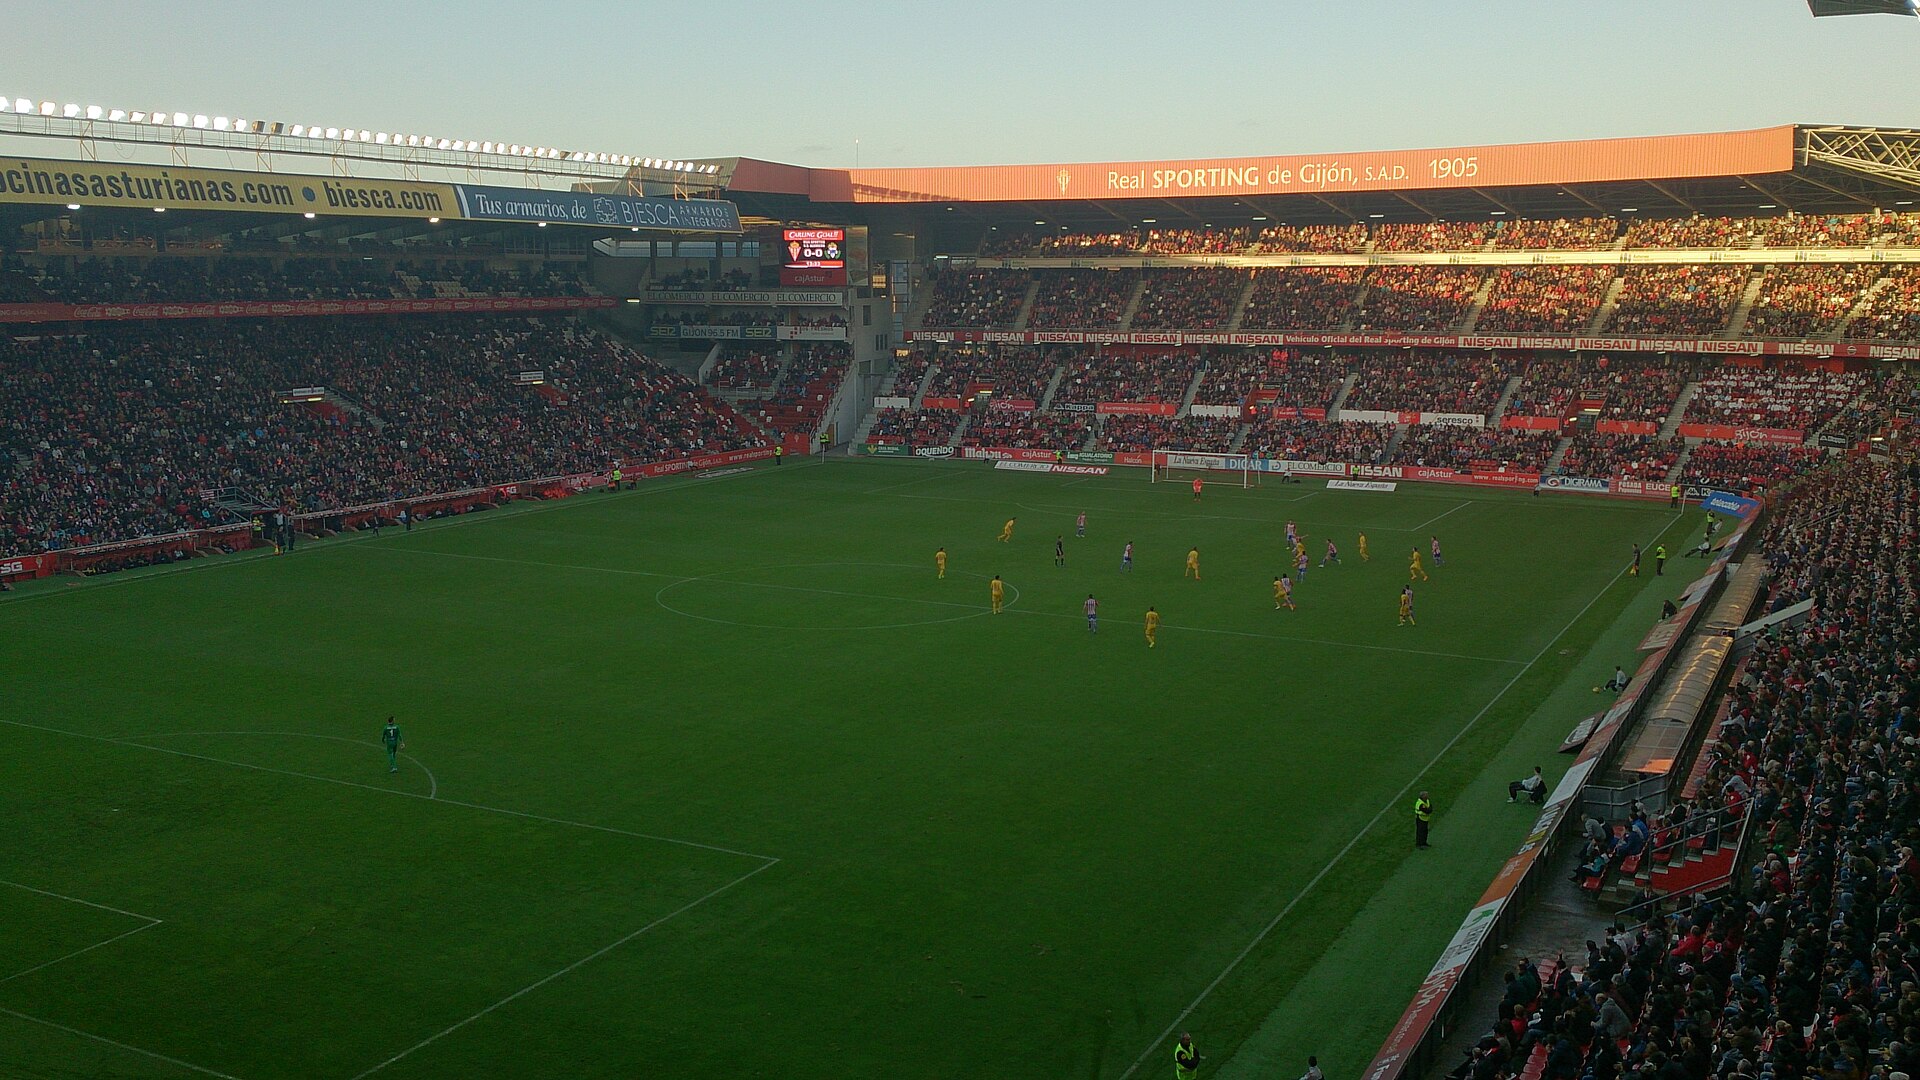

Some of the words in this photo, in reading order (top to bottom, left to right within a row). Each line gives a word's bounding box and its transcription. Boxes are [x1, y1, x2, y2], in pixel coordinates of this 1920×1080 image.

[1107, 170, 1146, 190] Real
[1151, 166, 1260, 189] SPORTING
[1267, 164, 1292, 185] de
[1299, 160, 1359, 189] Gijón,
[1364, 165, 1410, 181] S.A.D.
[1428, 156, 1479, 179] 1905
[323, 181, 443, 211] biesca.com
[475, 193, 502, 215] Tus
[505, 198, 570, 222] armarios,
[572, 203, 587, 220] de
[620, 200, 681, 226] BIESCA
[680, 204, 731, 219] ARMARIOS
[681, 216, 733, 229] INTEGRADOS
[803, 248, 823, 258] 0-0
[794, 274, 825, 283] cajAstur
[711, 293, 722, 301] EL
[723, 293, 770, 302] COMERCIO
[776, 293, 788, 302] EL
[788, 293, 837, 302] COMERCIO
[650, 326, 677, 336] SER
[726, 329, 739, 337] FM
[745, 327, 772, 337] SER
[912, 332, 955, 342] NISSAN
[982, 332, 1025, 342] NISSAN
[1038, 333, 1081, 343] NISSAN
[1085, 333, 1129, 343] NISSAN
[1134, 334, 1178, 344] NISSAN
[1183, 334, 1229, 344] NISSAN
[1234, 334, 1280, 344] NISSAN
[1321, 335, 1348, 344] Oficial
[1349, 335, 1363, 344] del
[1363, 335, 1382, 344] Real
[1421, 336, 1432, 344] de
[1432, 336, 1455, 346] Gijón
[1462, 337, 1513, 347] NISSAN
[1519, 338, 1572, 348] NISSAN
[1579, 339, 1632, 349] NISSAN
[1638, 340, 1695, 351] NISSAN
[1702, 342, 1758, 353] NISSAN
[1778, 343, 1835, 356] NISSAN
[1869, 345, 1920, 359] NISSAN
[1436, 416, 1474, 425] seresco
[915, 446, 955, 456] OQUENDO
[1021, 449, 1053, 459] cajAstur
[664, 460, 691, 472] SPORTIN
[1051, 464, 1108, 475] NISSAN
[1417, 470, 1453, 479] cajAstur
[1564, 477, 1603, 488] DIGIRAMA
